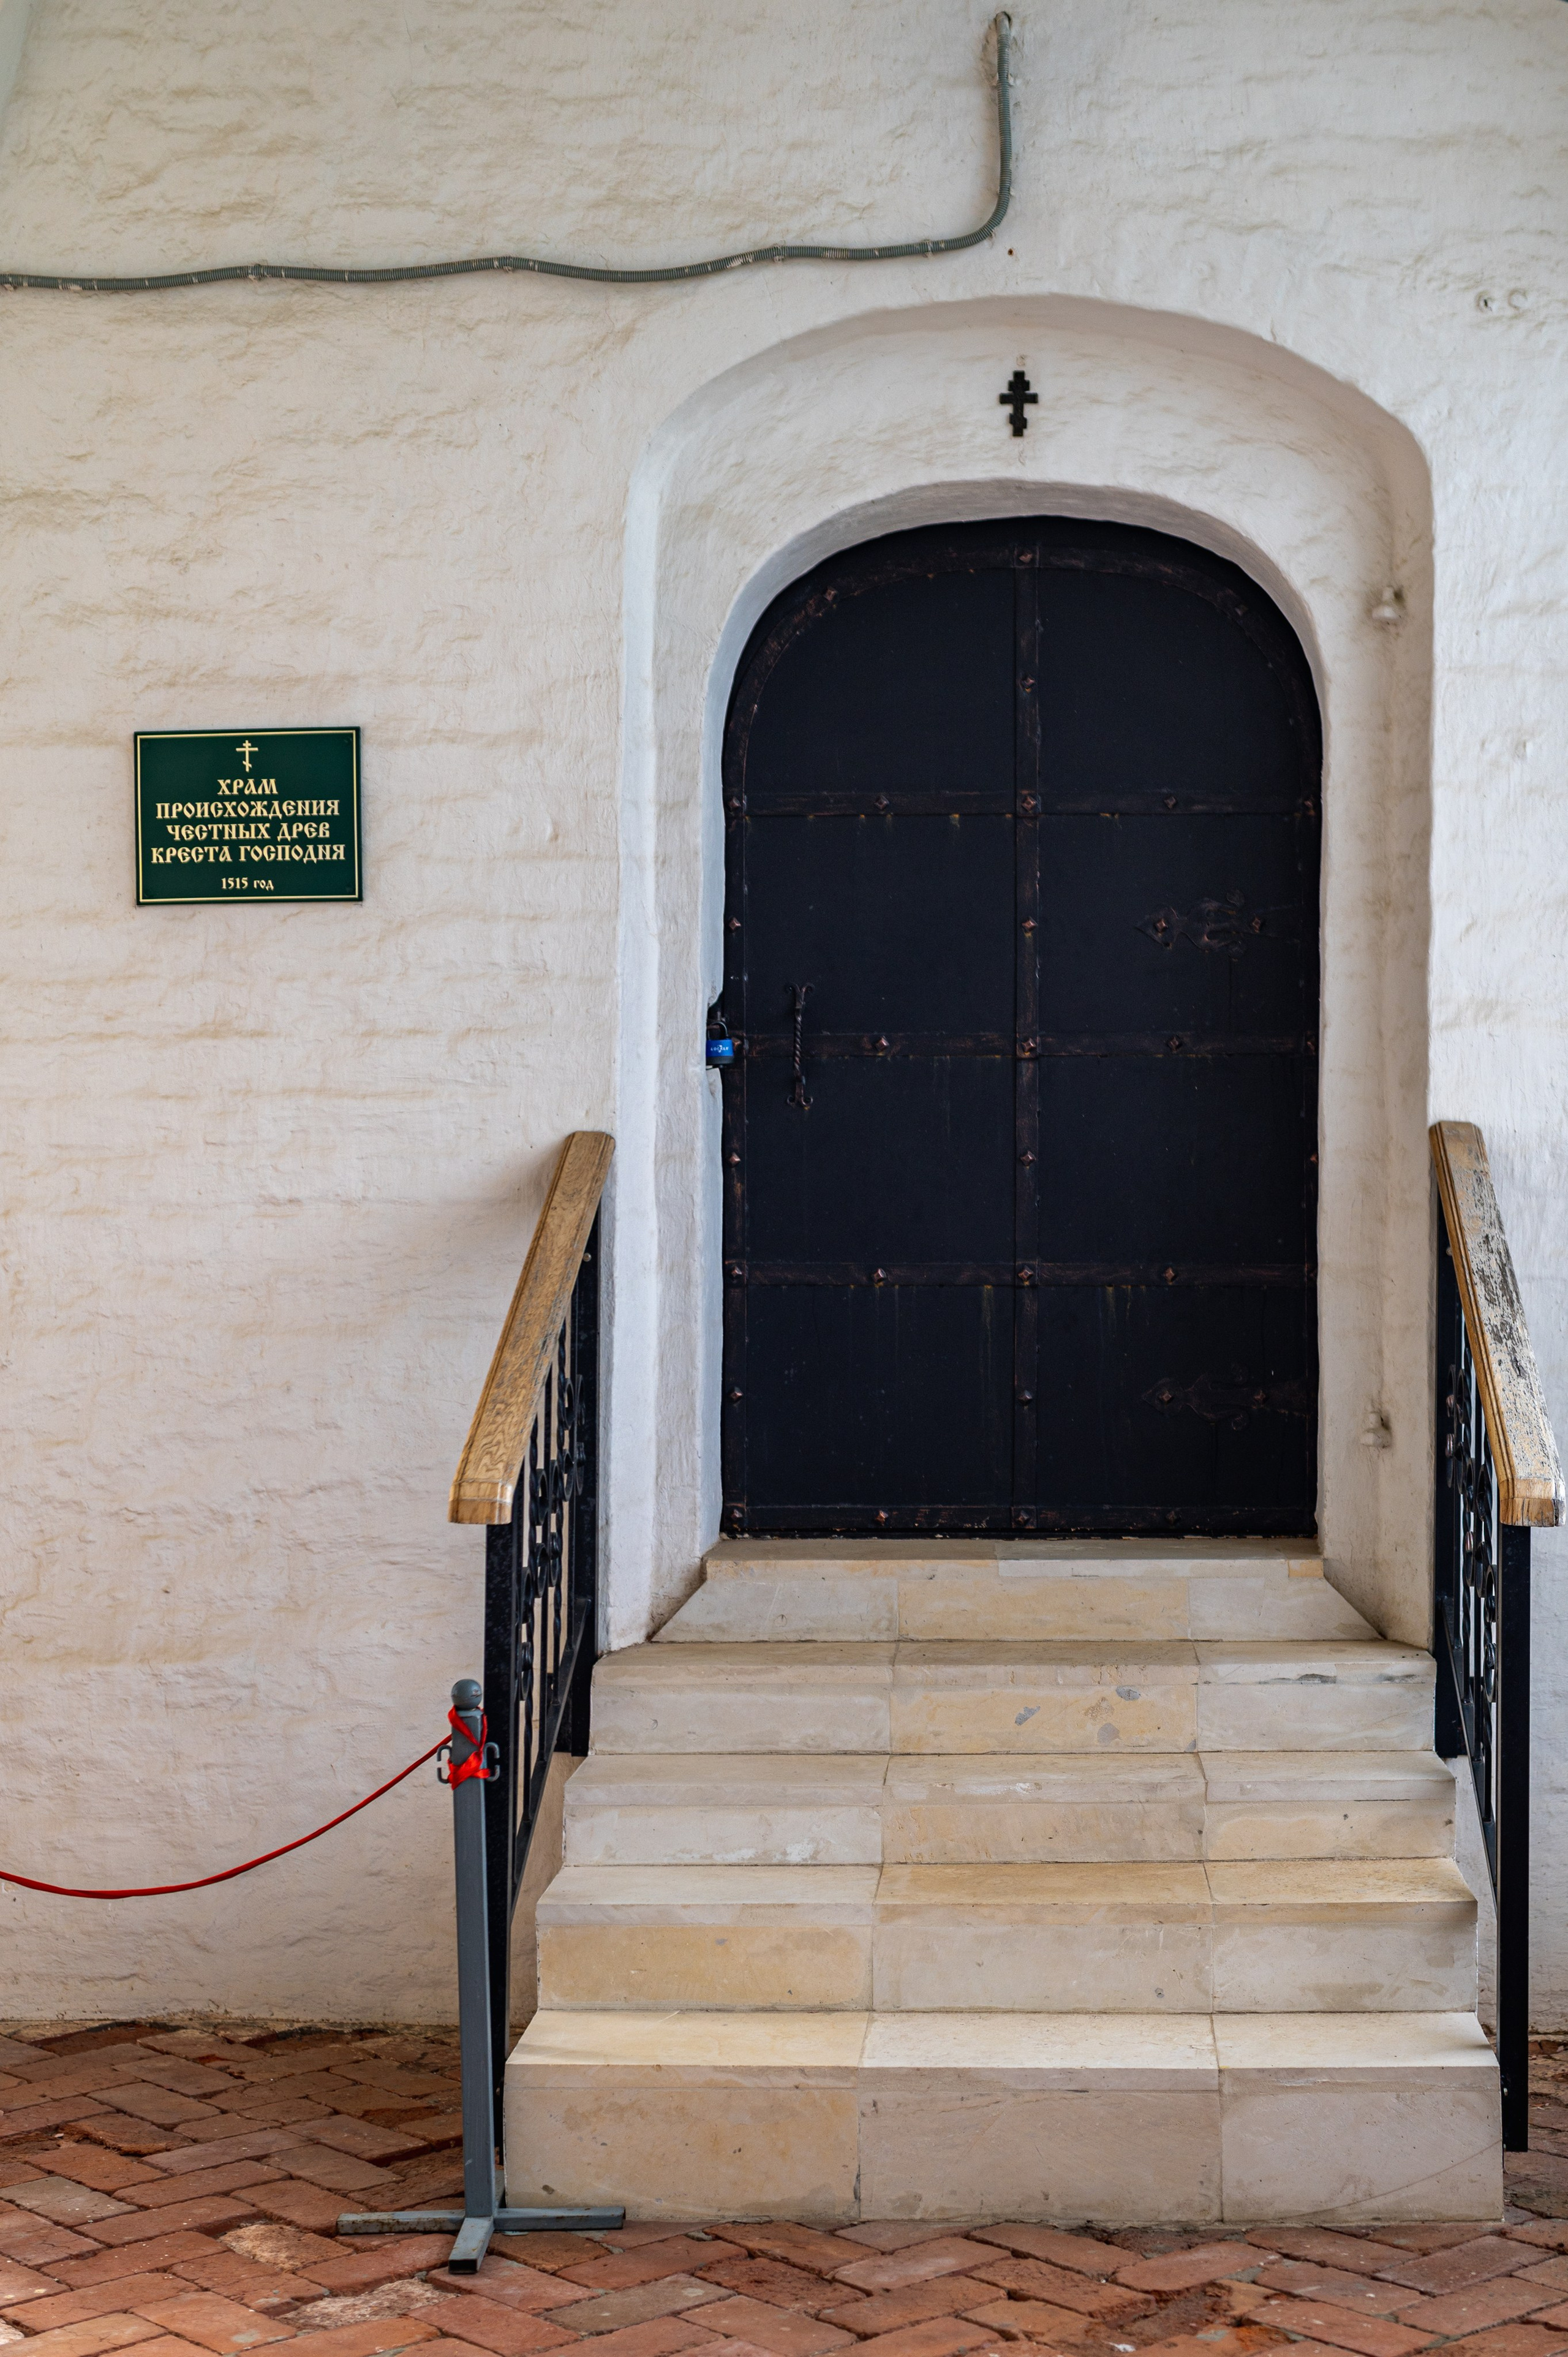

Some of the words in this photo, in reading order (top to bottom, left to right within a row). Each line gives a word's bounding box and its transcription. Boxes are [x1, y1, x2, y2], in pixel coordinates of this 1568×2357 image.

[217, 779, 278, 795] ХРАМ
[156, 799, 340, 820] ПРОИСХОЖДЕНИЯ
[166, 823, 271, 841] ЧЕСТНЫХ
[277, 822, 330, 842] ДРЕВ
[151, 845, 233, 864] КРЕСТА
[239, 844, 345, 864] ГОСПОДНЯ
[221, 877, 249, 889] 1515
[254, 879, 274, 891] год
